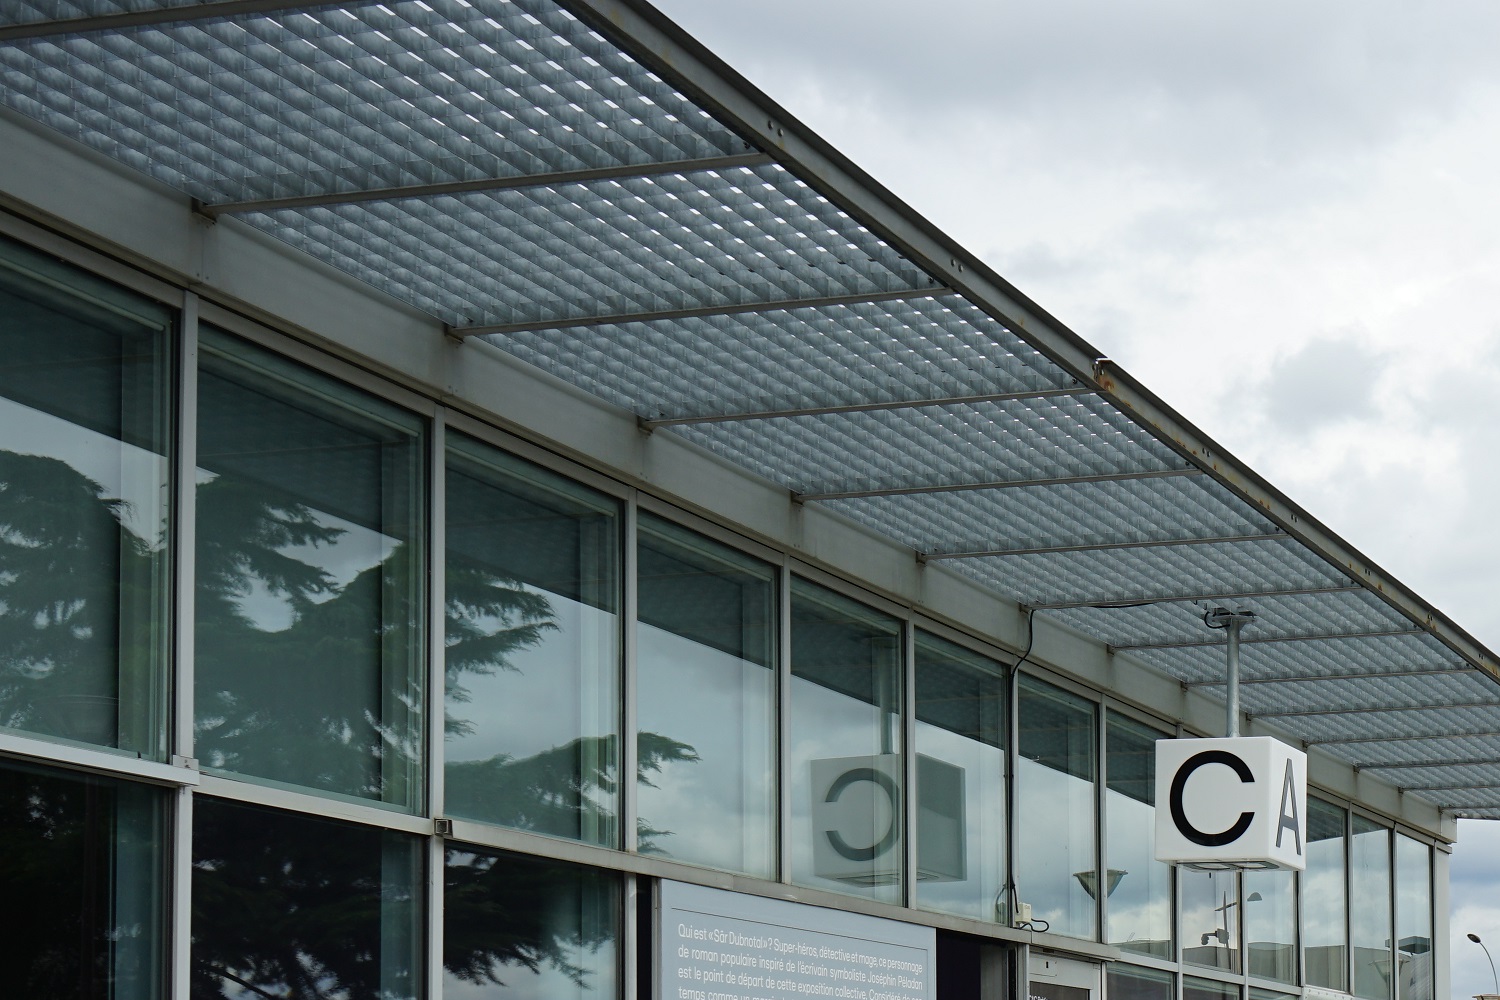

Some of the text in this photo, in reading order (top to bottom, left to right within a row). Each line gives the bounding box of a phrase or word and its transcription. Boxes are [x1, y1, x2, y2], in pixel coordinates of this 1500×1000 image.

[678, 923, 692, 938] Qui
[693, 928, 707, 940] est
[819, 946, 850, 962] détective
[851, 952, 857, 963] et
[878, 958, 886, 967] ce
[678, 944, 689, 958] de
[691, 949, 718, 962] roman
[720, 953, 756, 968] populaire
[759, 955, 783, 973] inspiré
[785, 959, 795, 972] de
[867, 971, 896, 988] Joséphin
[897, 975, 922, 989] Péladan
[678, 967, 691, 979] est
[694, 966, 701, 980] le
[703, 969, 723, 984] point
[725, 970, 736, 984] de
[738, 972, 763, 989] départ
[765, 976, 775, 989] de
[776, 979, 796, 991] cette
